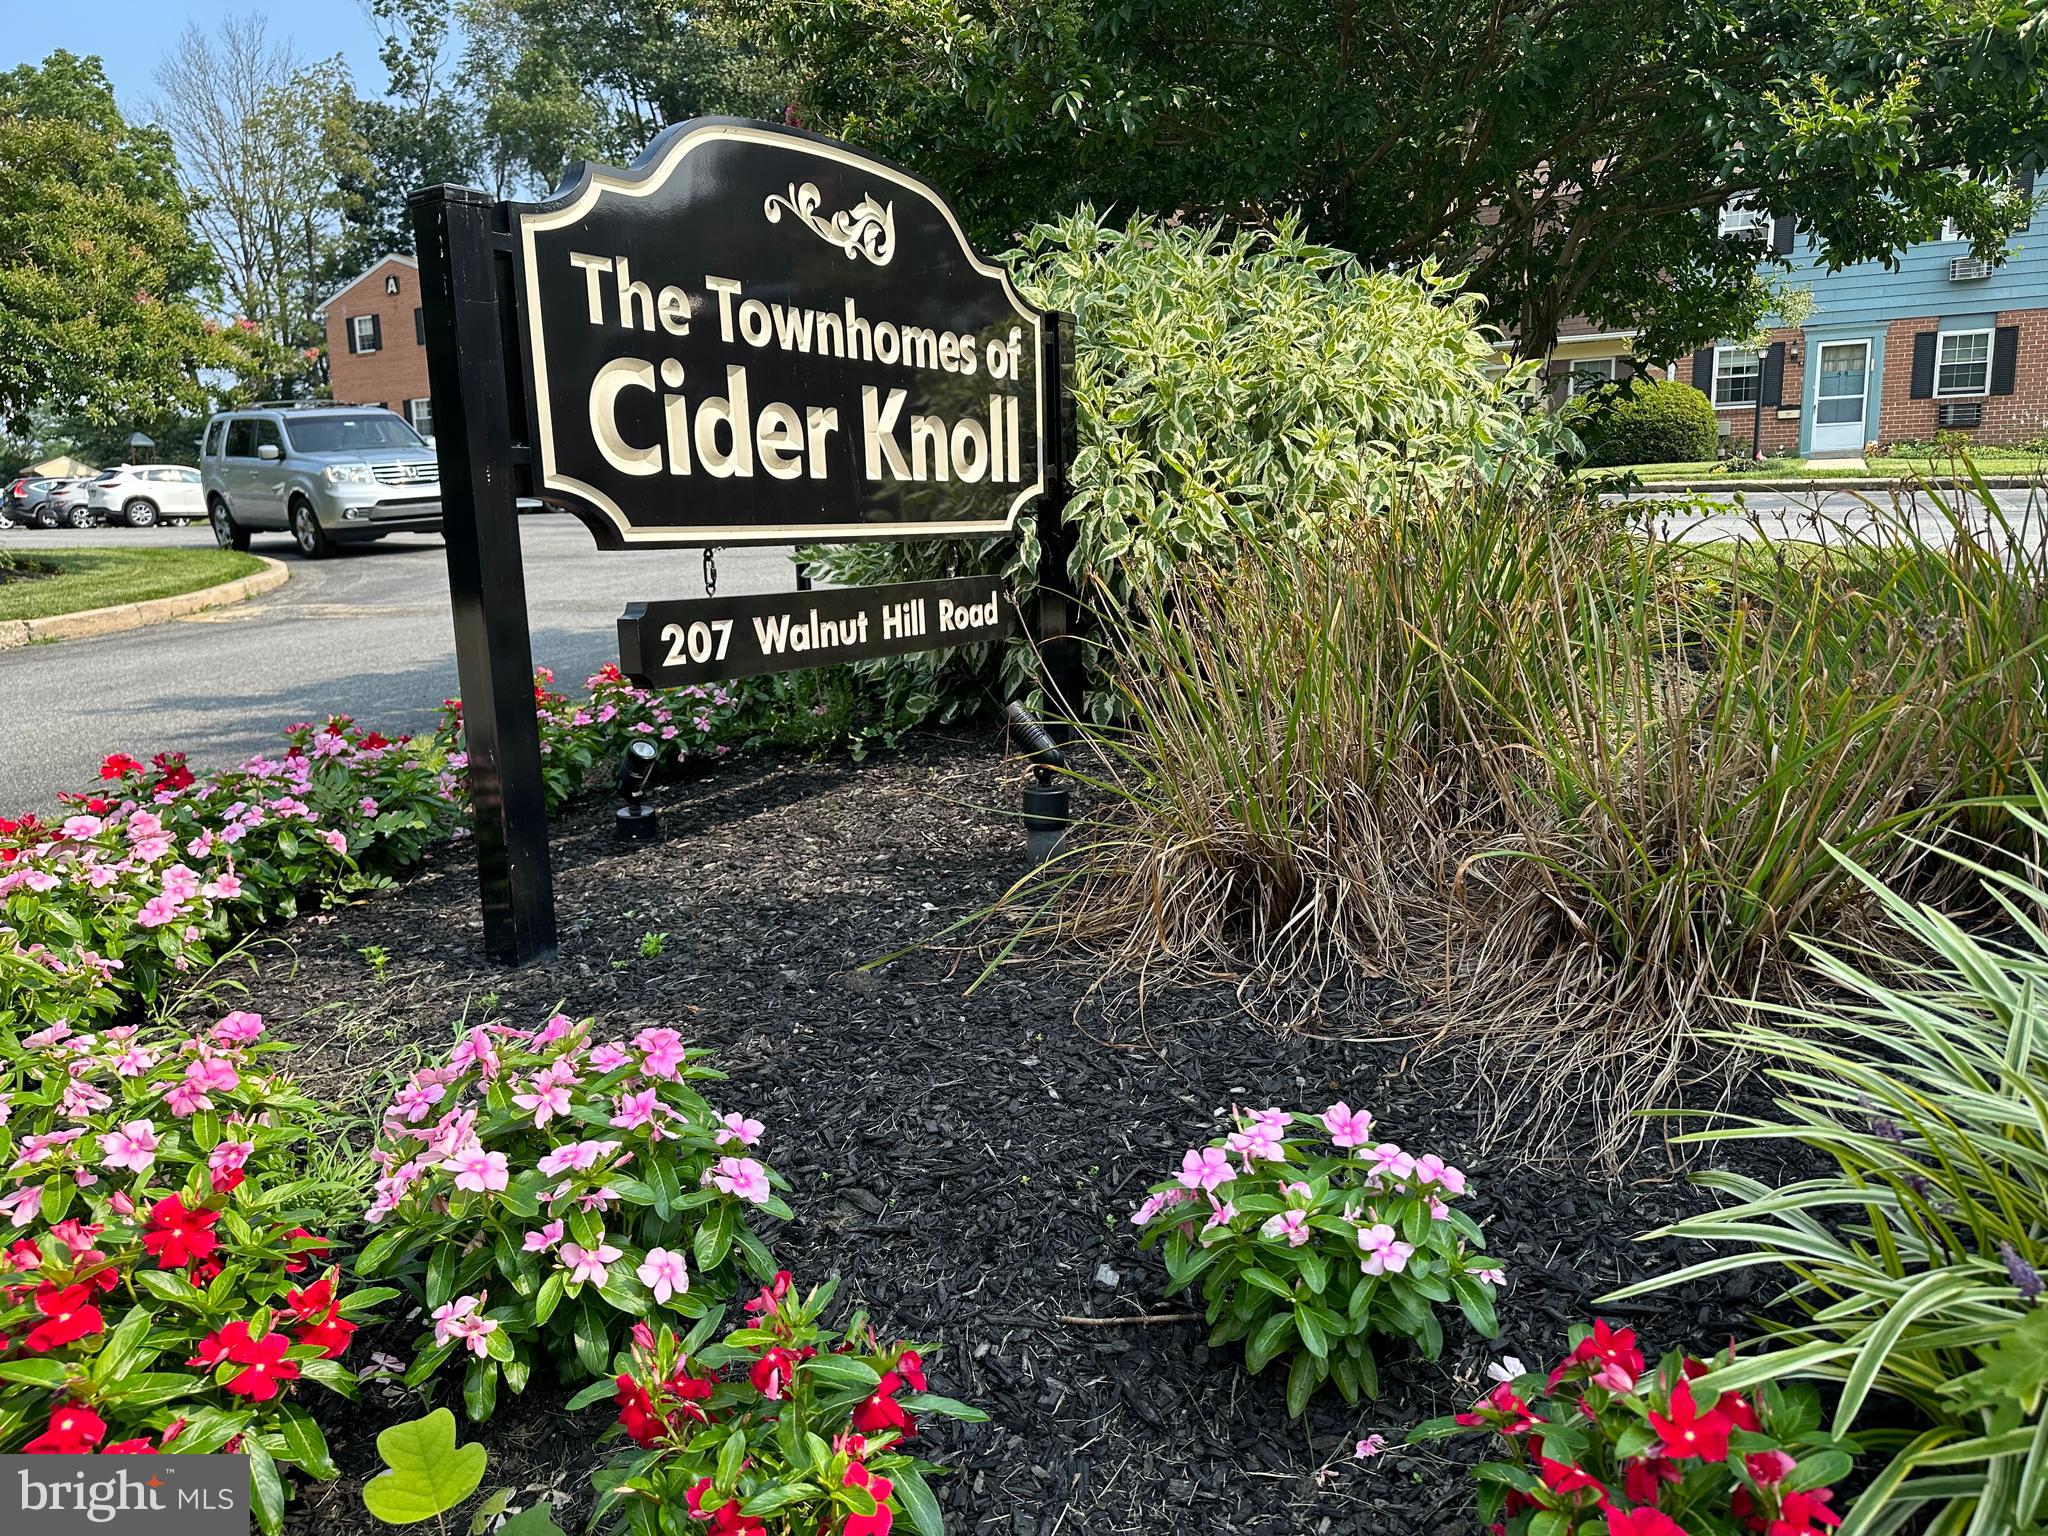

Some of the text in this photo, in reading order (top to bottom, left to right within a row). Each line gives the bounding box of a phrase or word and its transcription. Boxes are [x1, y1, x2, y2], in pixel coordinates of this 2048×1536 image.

[387, 278, 397, 294] A
[570, 251, 1022, 381] The Townhomes of
[589, 356, 1020, 484] Cider Knoll
[660, 590, 999, 667] 207 Walnut Hill Road
